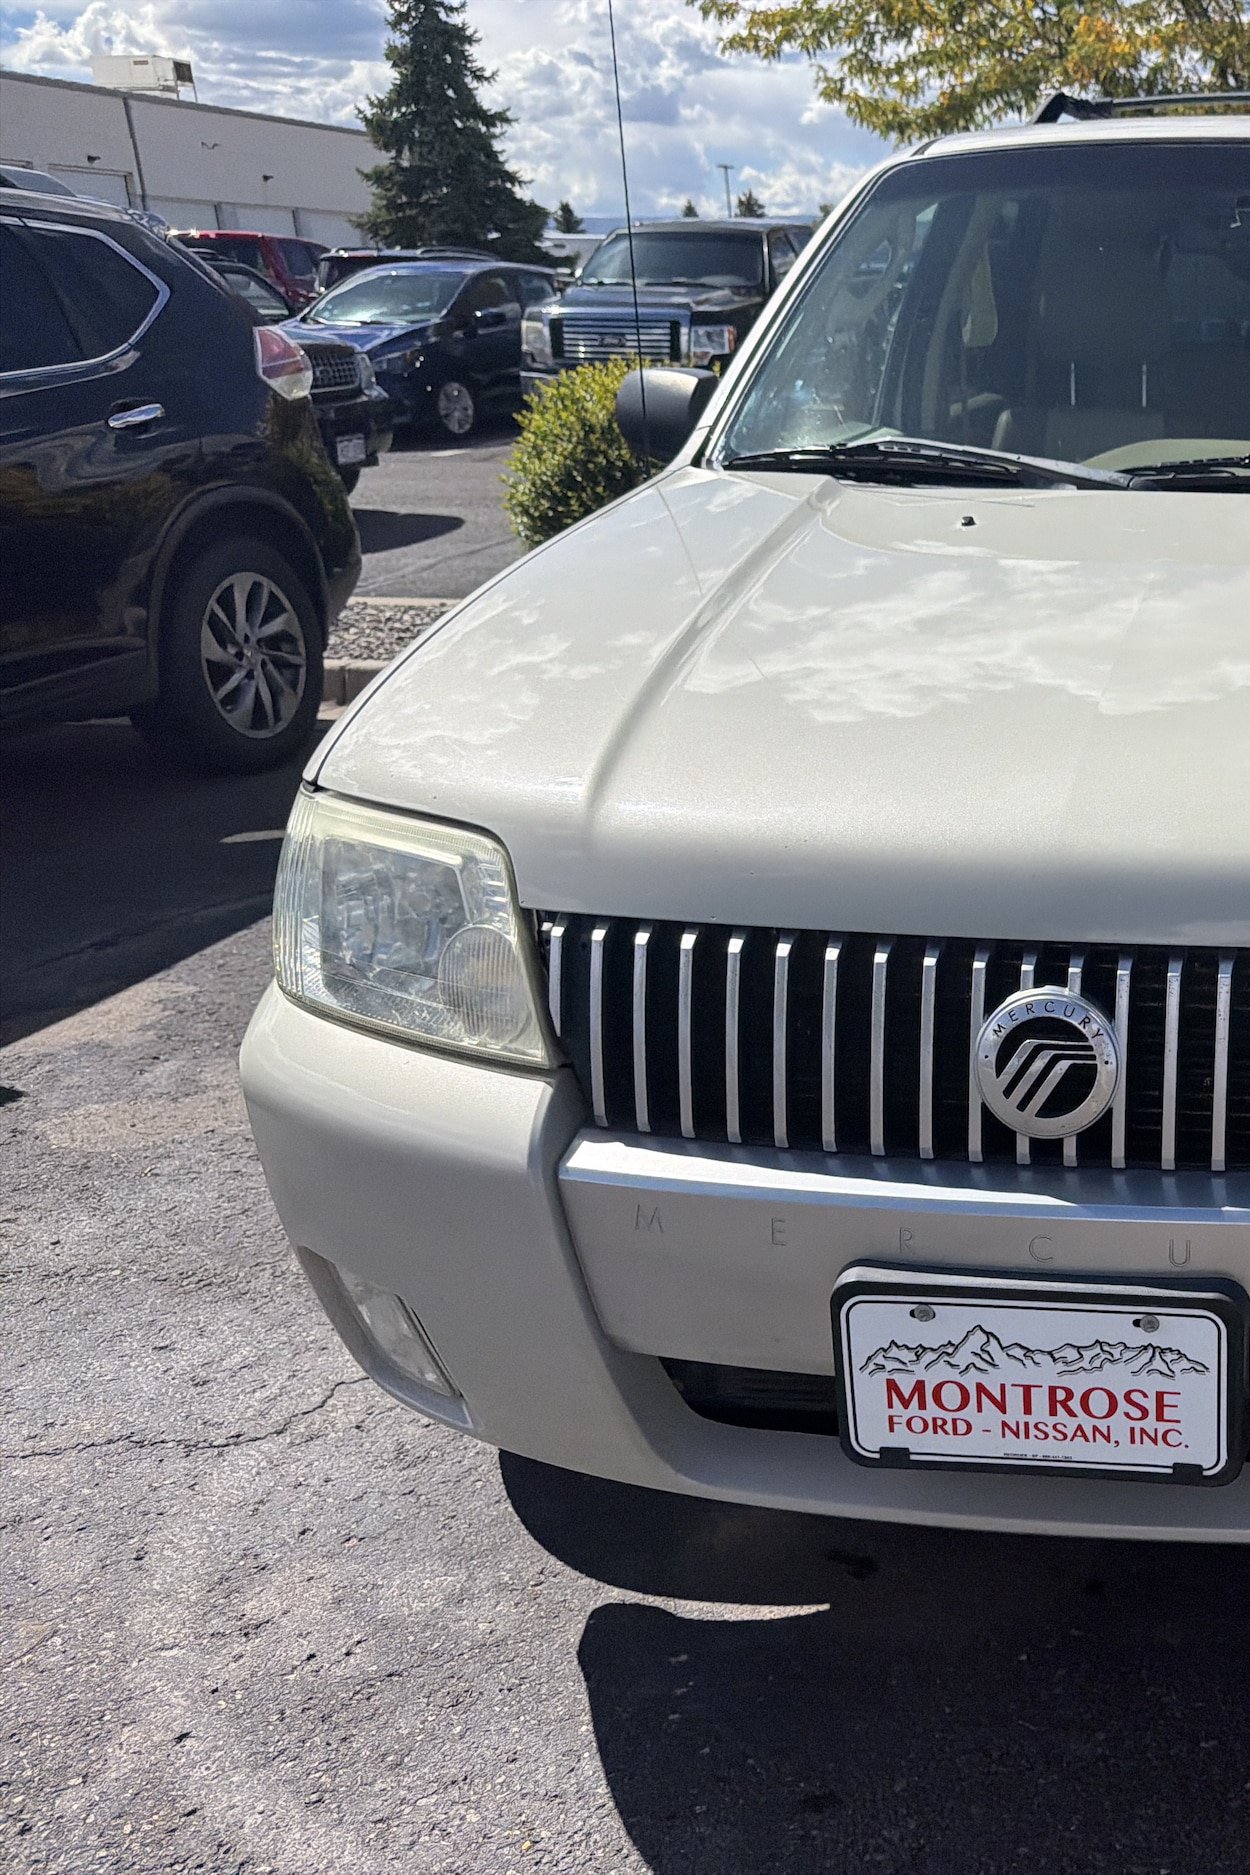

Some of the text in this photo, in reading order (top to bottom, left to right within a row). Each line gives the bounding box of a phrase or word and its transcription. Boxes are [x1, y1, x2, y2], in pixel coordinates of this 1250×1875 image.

[993, 1001, 1103, 1039] MERCURY
[886, 1378, 1182, 1424] MONTROSE
[888, 1414, 973, 1437] FORD
[1001, 1420, 1120, 1448] NISSAN,
[1129, 1427, 1190, 1449] INC.
